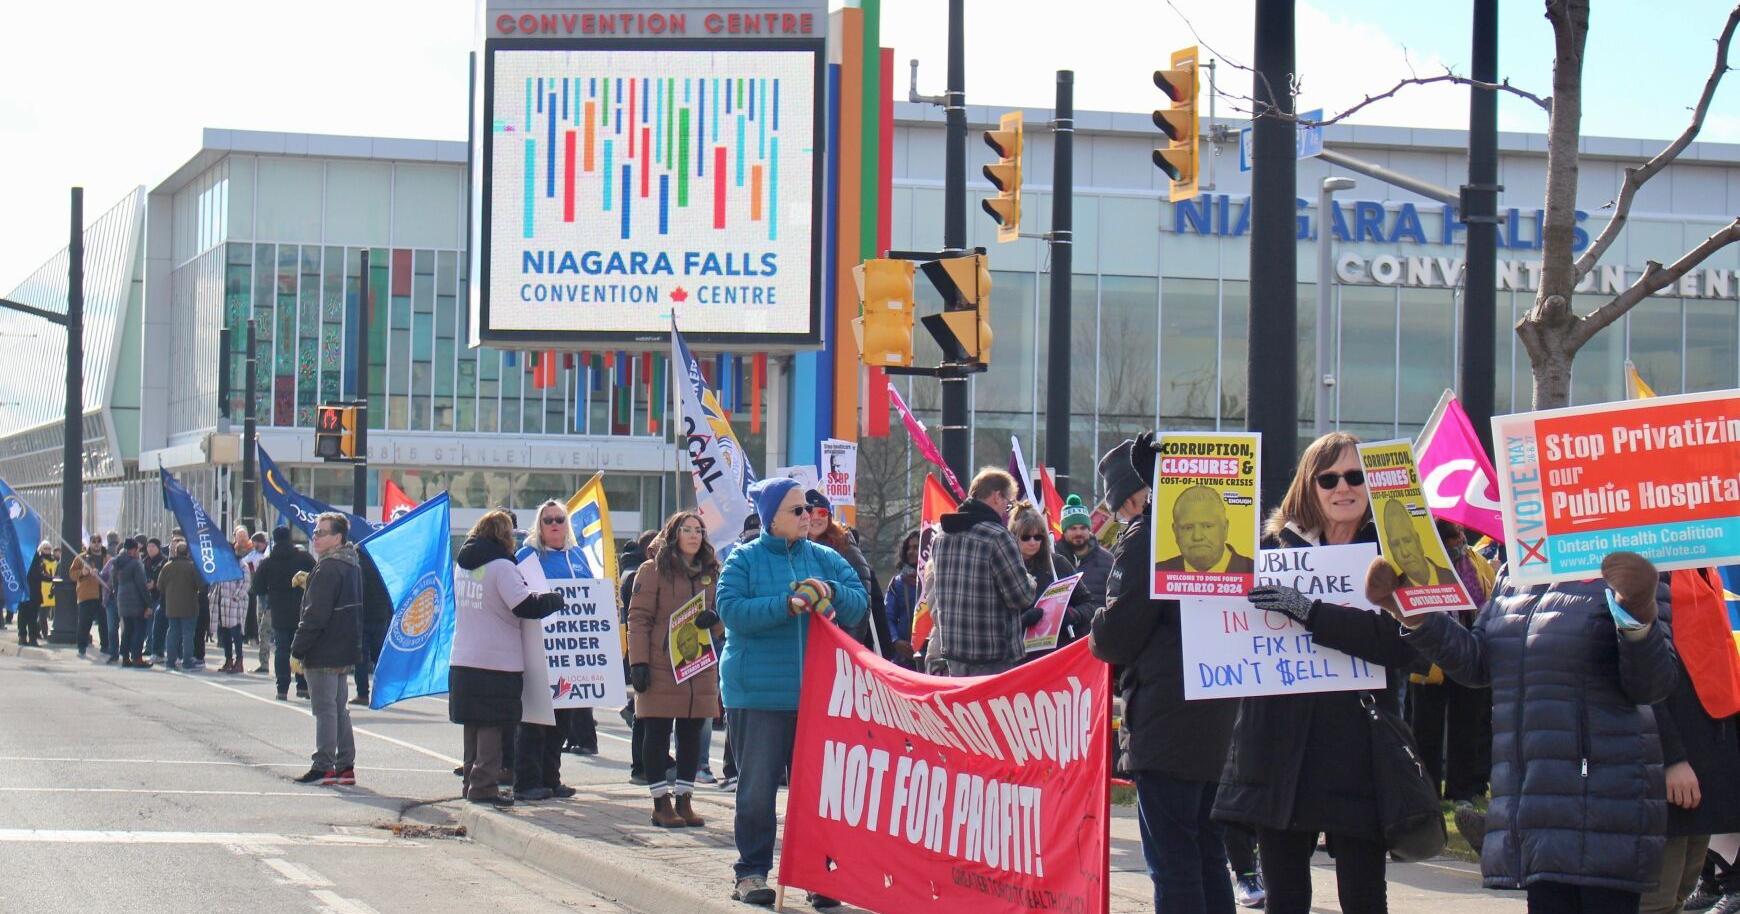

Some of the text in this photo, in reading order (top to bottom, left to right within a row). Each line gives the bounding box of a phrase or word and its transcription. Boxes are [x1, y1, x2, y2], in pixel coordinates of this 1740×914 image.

[496, 13, 814, 34] CONVENTION CENTRE
[522, 250, 778, 277] NIAGARA FALLS
[520, 283, 777, 305] CONVENTION CENTRE
[434, 447, 529, 465] STANLEY
[543, 450, 625, 467] AVENUE
[1162, 442, 1254, 459] CORRUPTION,
[1507, 436, 1526, 465] MAY
[1545, 433, 1605, 461] Stop
[1161, 458, 1254, 476] CLOSURES &
[1363, 451, 1414, 468] CORRUPTION,
[1160, 476, 1254, 487] COST-OF-LIVING CRISIS
[1367, 468, 1417, 488] CLOSURES &
[1548, 466, 1583, 487] our
[826, 484, 851, 497] FORD!
[1512, 468, 1545, 533] VOTE
[1551, 473, 1740, 519] Public Hospita
[1557, 524, 1724, 554] Ontario Health Coalition
[1166, 574, 1195, 582] WELCOME
[1166, 582, 1243, 594] ONTARIO 2024
[1293, 574, 1354, 595] CARE
[550, 586, 590, 599] ON'T
[1409, 595, 1443, 607] ONTARIO
[558, 602, 597, 617] ROW
[544, 619, 611, 634] ORKERS
[1222, 610, 1249, 634] IN
[543, 636, 600, 651] UNDER
[1253, 635, 1287, 656] FIX
[545, 653, 608, 668] HE BUS
[1198, 657, 1262, 688] DON'T
[568, 683, 606, 700] ATU
[987, 676, 1093, 770] people
[818, 740, 1044, 878] NOT FOR PROFIT!
